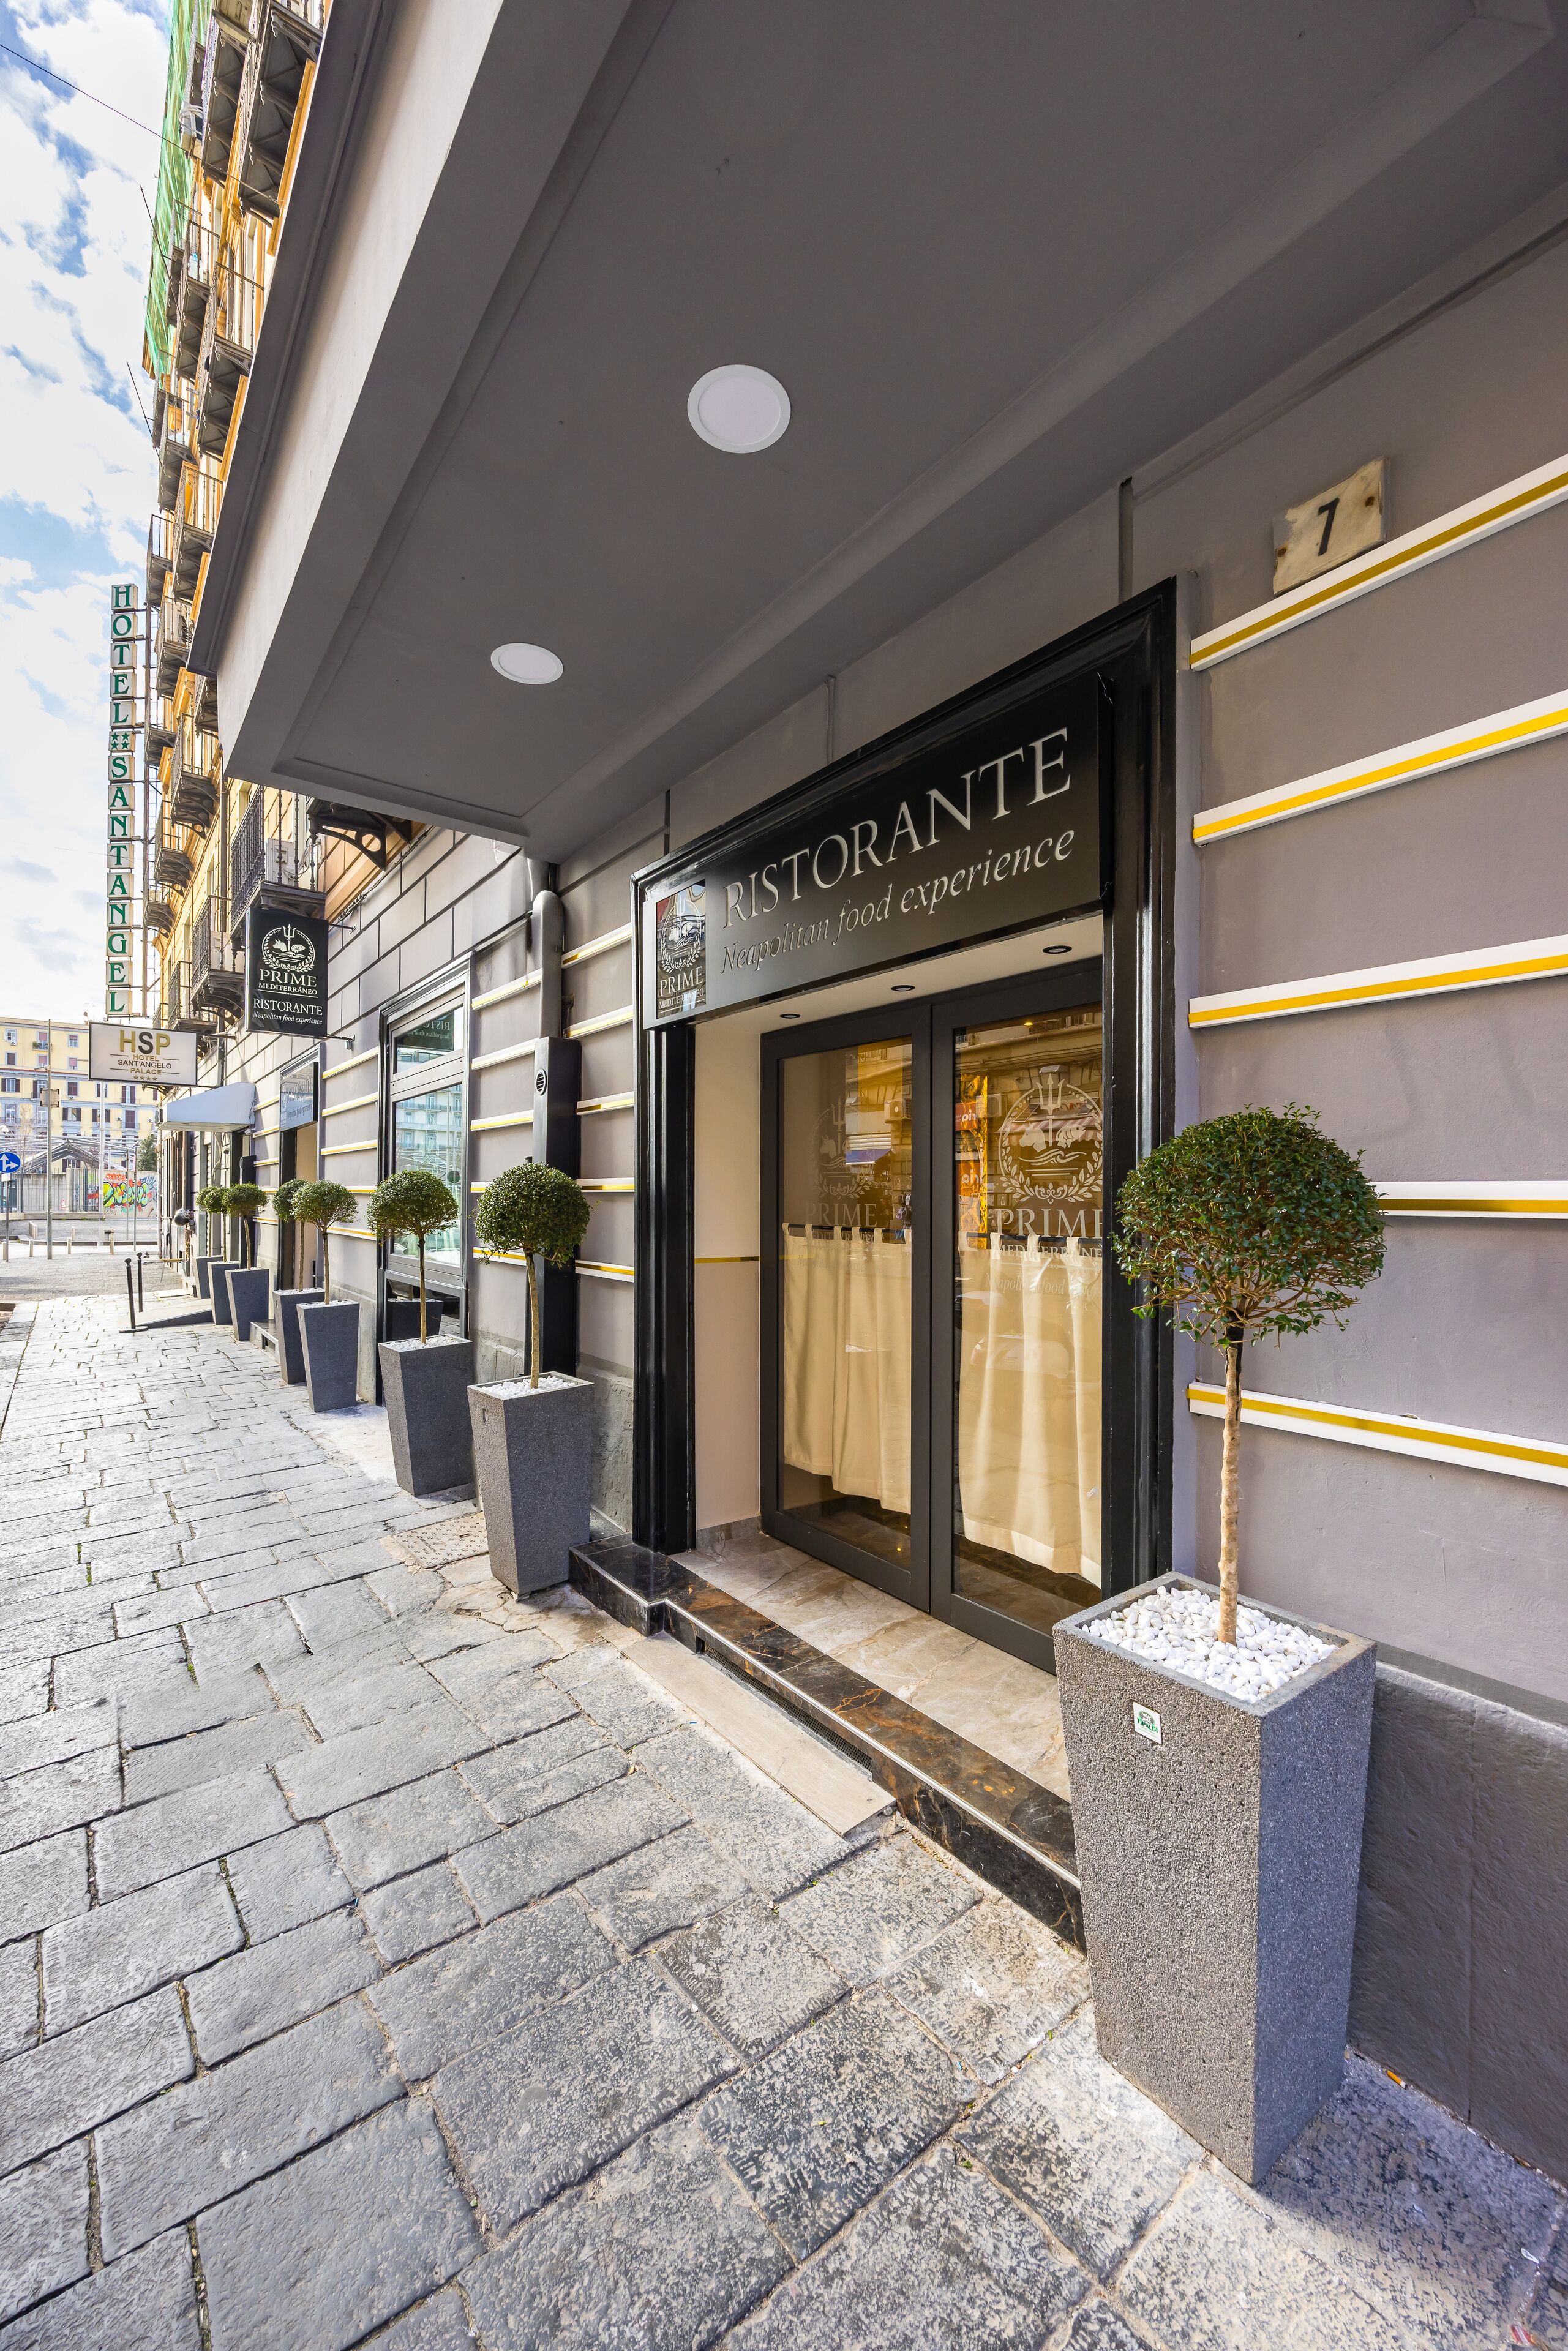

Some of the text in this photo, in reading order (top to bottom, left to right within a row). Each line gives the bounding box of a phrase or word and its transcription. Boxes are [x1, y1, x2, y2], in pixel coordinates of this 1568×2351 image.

[108, 586, 132, 1012] HOTEL SANTANGEL
[723, 727, 1070, 929] RISTORANTE
[721, 830, 1075, 974] Neapolitan food experience
[258, 982, 318, 995] MEDITERRÁNEO
[260, 969, 317, 988] PRIME
[659, 966, 703, 997] PRIME
[253, 998, 323, 1016] RISTORANTE
[253, 1011, 282, 1021] Neapolitan
[119, 1030, 171, 1055] HSP
[118, 1059, 172, 1069] SANT'ANGELO
[805, 1203, 877, 1228] PRIME
[1041, 1278, 1065, 1295] food
